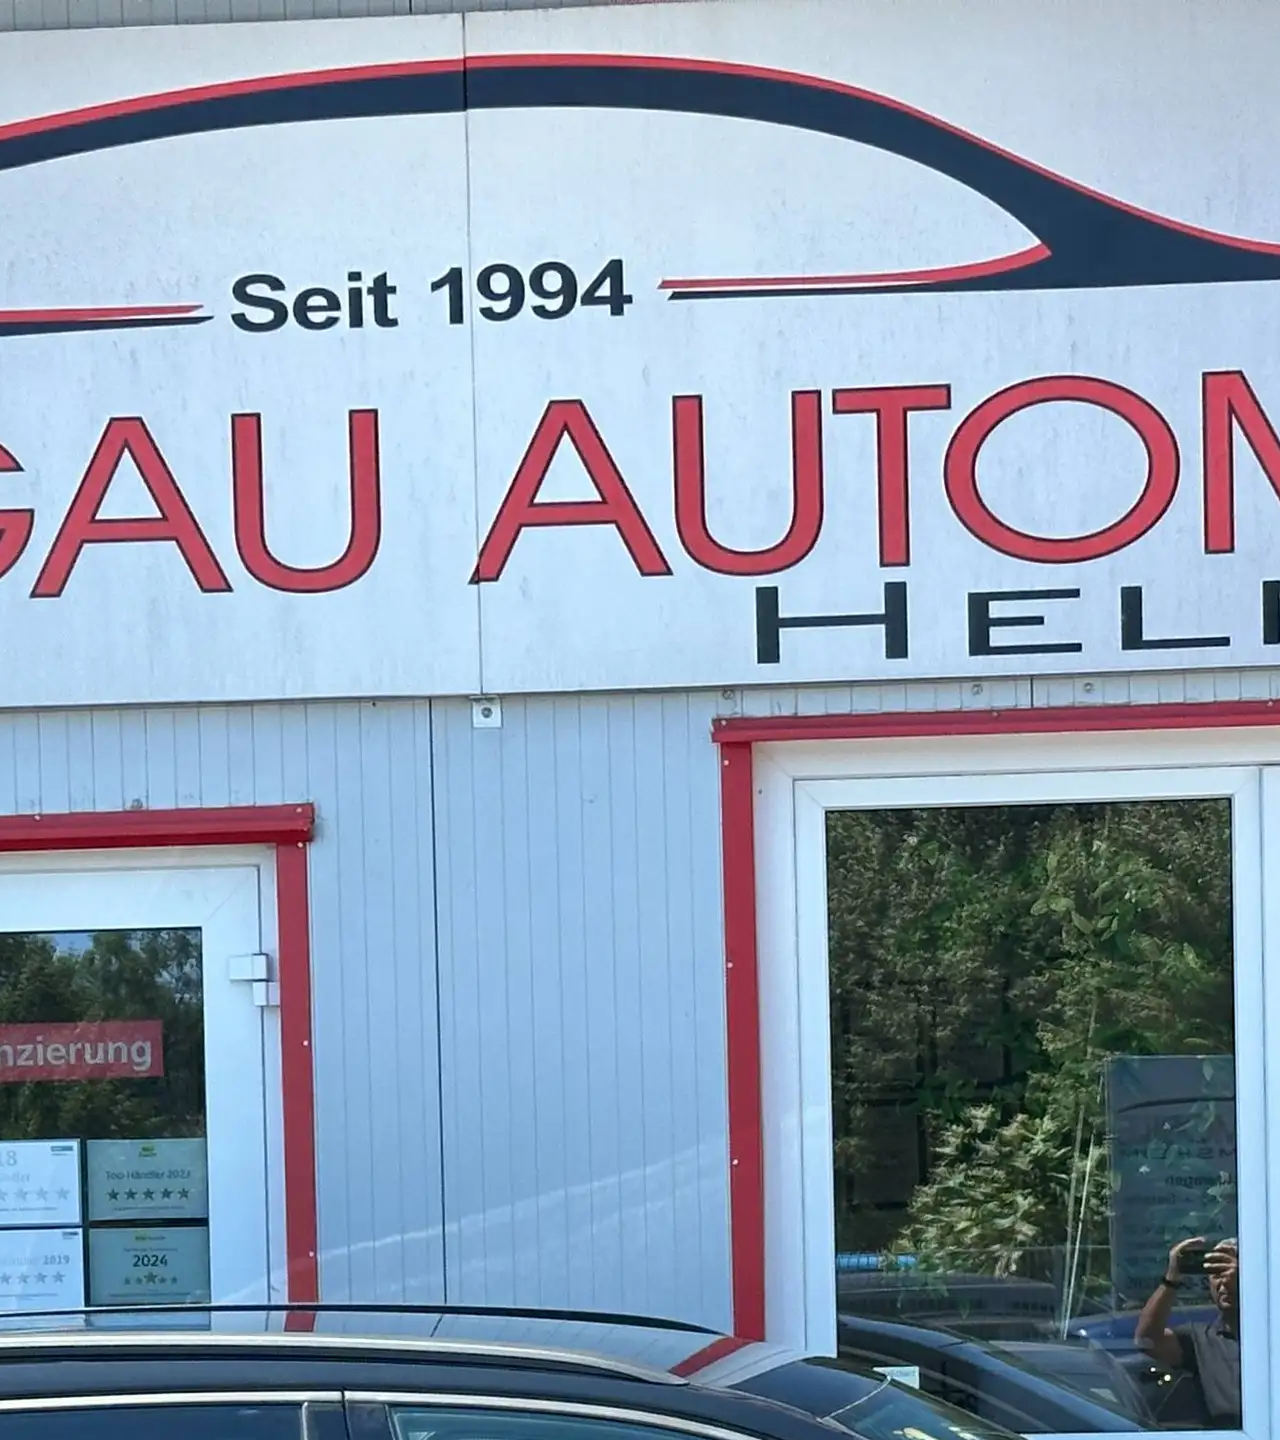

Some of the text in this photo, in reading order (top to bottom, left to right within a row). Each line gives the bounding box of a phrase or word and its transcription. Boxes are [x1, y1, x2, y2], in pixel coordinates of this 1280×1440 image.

[231, 259, 633, 332] Seit 1994
[132, 1254, 168, 1267] 2024
